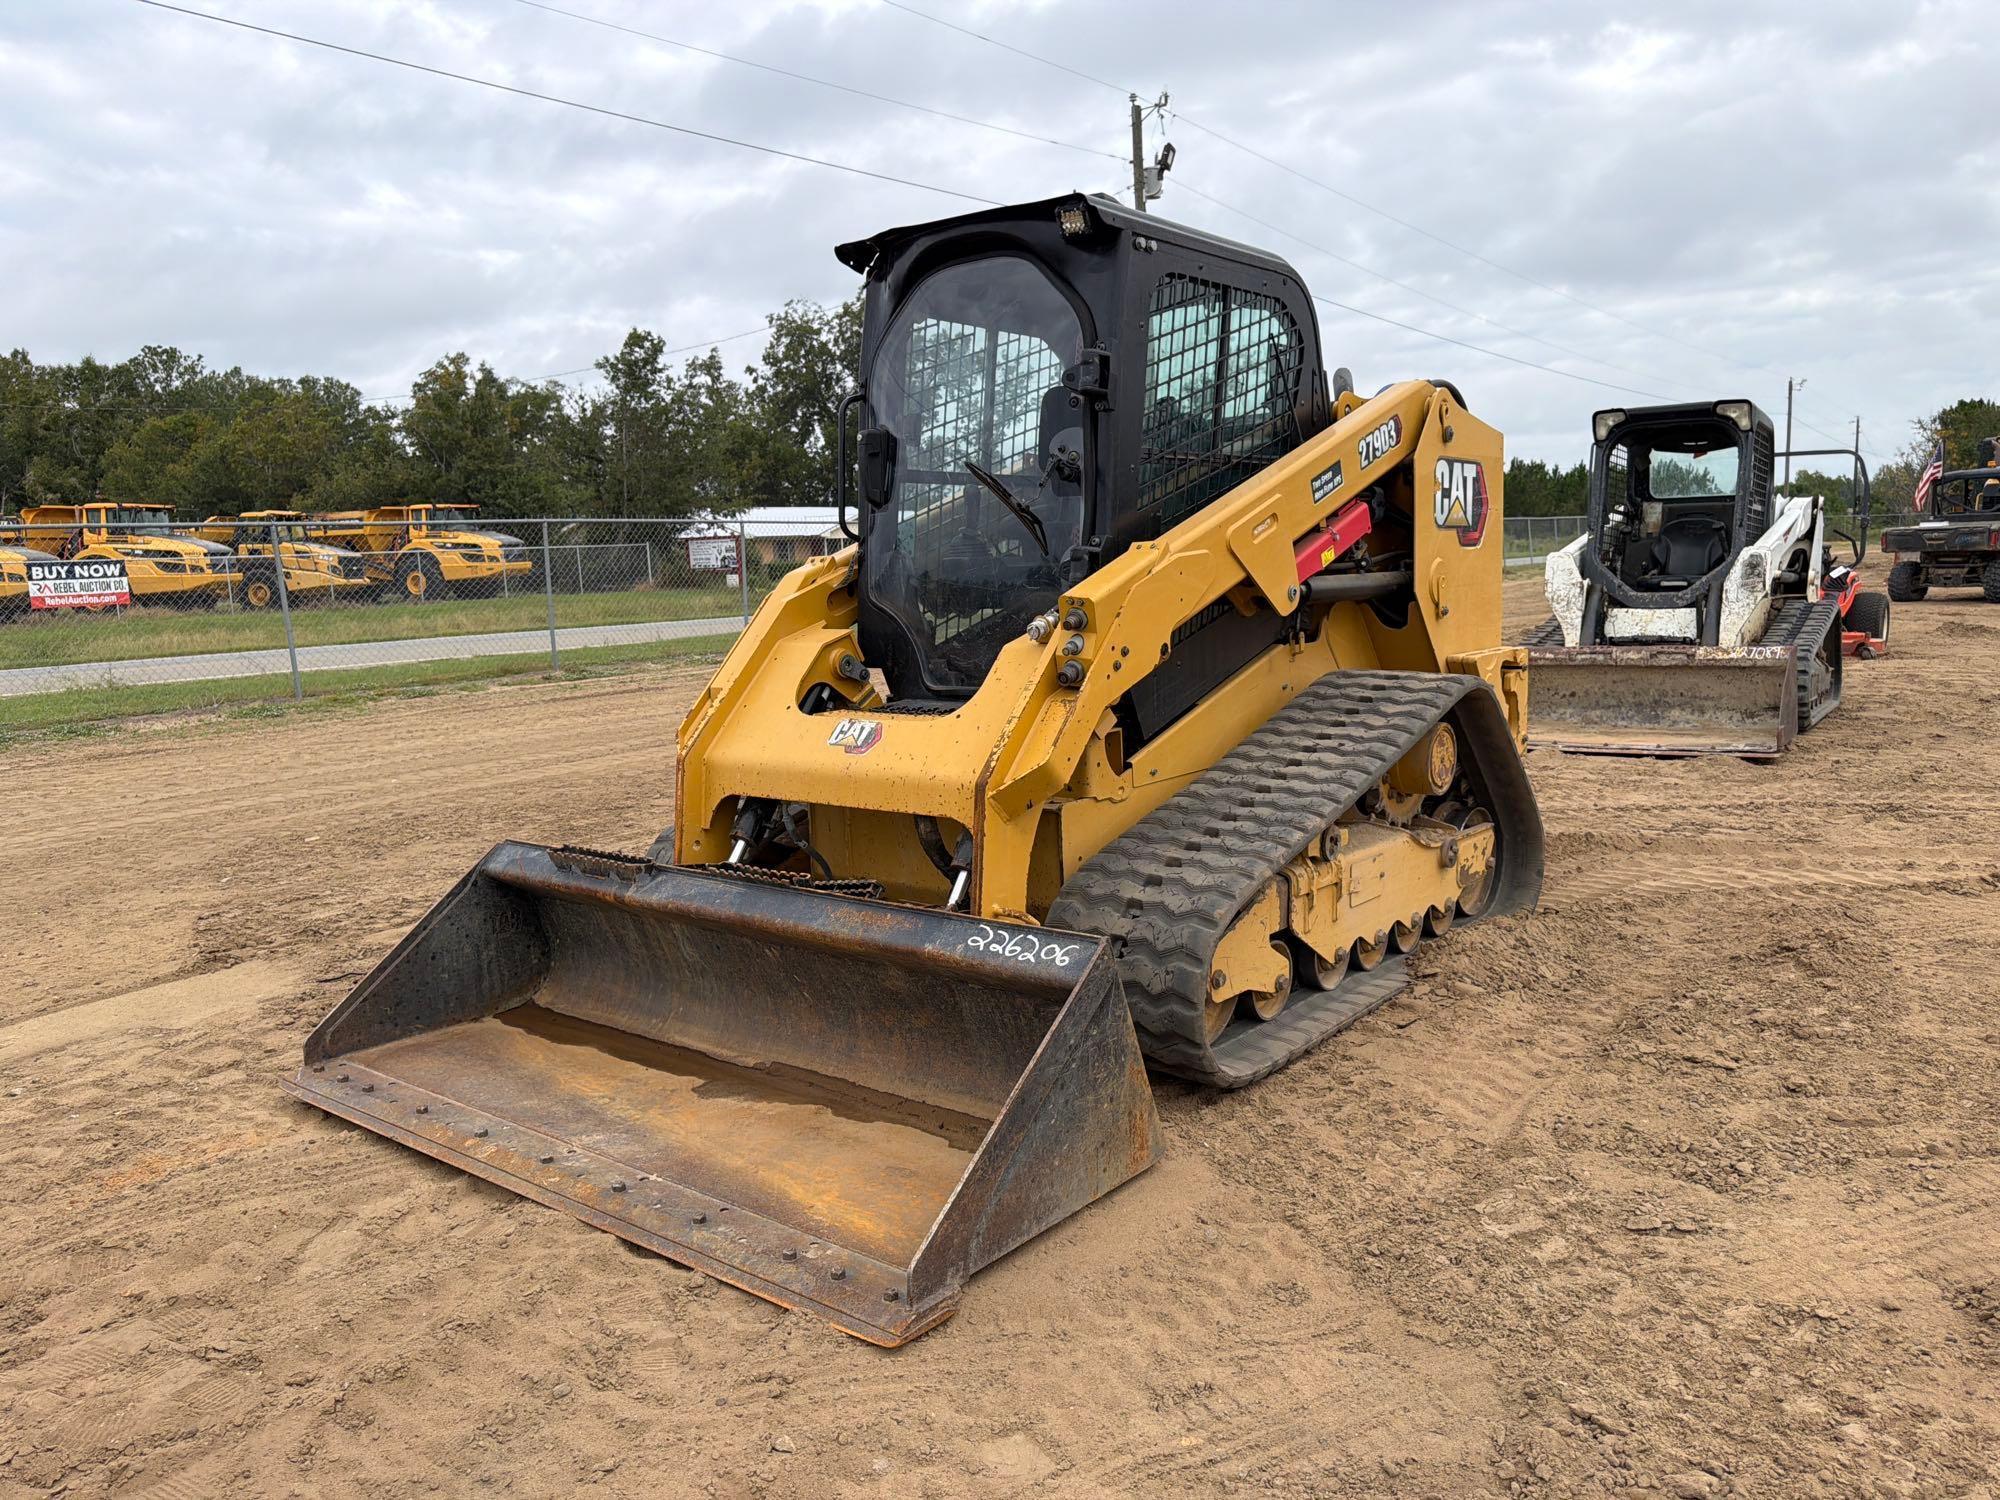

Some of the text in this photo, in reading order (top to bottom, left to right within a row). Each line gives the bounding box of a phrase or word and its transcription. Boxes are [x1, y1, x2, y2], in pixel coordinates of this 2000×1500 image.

[1359, 420, 1396, 468] 279D3
[1435, 459, 1477, 527] CAT
[31, 563, 120, 580] BUY NOW
[53, 582, 78, 593] REBEL
[79, 580, 112, 593] AUCTION
[45, 595, 117, 606] RebelAuction.com
[828, 720, 877, 747] CAT
[967, 925, 1080, 967] 226206
